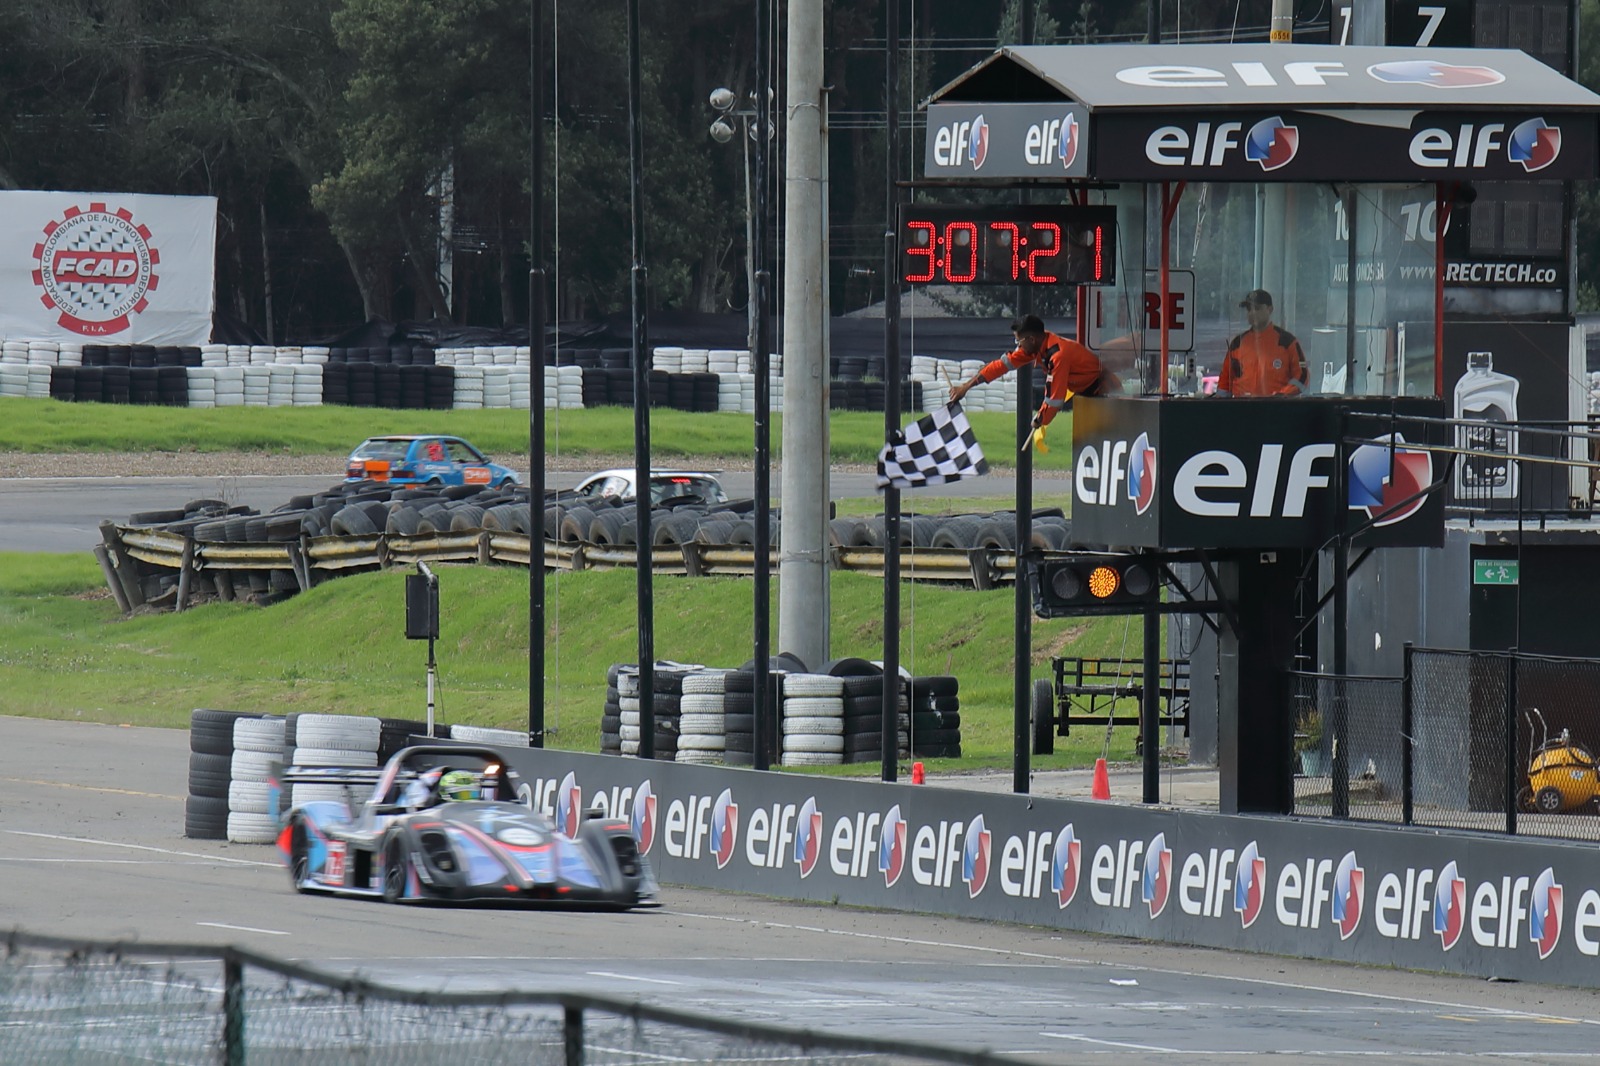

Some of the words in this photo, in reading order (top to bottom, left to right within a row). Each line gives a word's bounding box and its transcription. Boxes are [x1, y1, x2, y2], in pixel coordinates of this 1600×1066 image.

[1417, 7, 1446, 46] 7
[1116, 62, 1349, 87] elf
[934, 121, 969, 166] elf
[1025, 119, 1059, 164] elf
[1145, 122, 1242, 166] elf
[1409, 124, 1504, 167] elf
[43, 215, 85, 263] COLOMBIANA
[87, 214, 99, 222] DE
[101, 215, 149, 273] AUTOMOVILISMO
[1400, 201, 1451, 242] 10
[43, 266, 79, 316] FEDERACION
[56, 257, 138, 278] FCAD
[112, 275, 149, 317] DEPORTIVO
[1076, 440, 1127, 506] elf
[1173, 443, 1336, 518] elf
[665, 795, 712, 859] elf
[746, 803, 795, 868] elf
[830, 812, 880, 877] elf
[912, 820, 963, 888] elf
[1000, 830, 1052, 898] elf
[1090, 840, 1143, 908] elf
[1179, 848, 1235, 918] elf
[1276, 858, 1332, 928] elf
[1375, 868, 1433, 940] elf
[1471, 876, 1529, 948] elf
